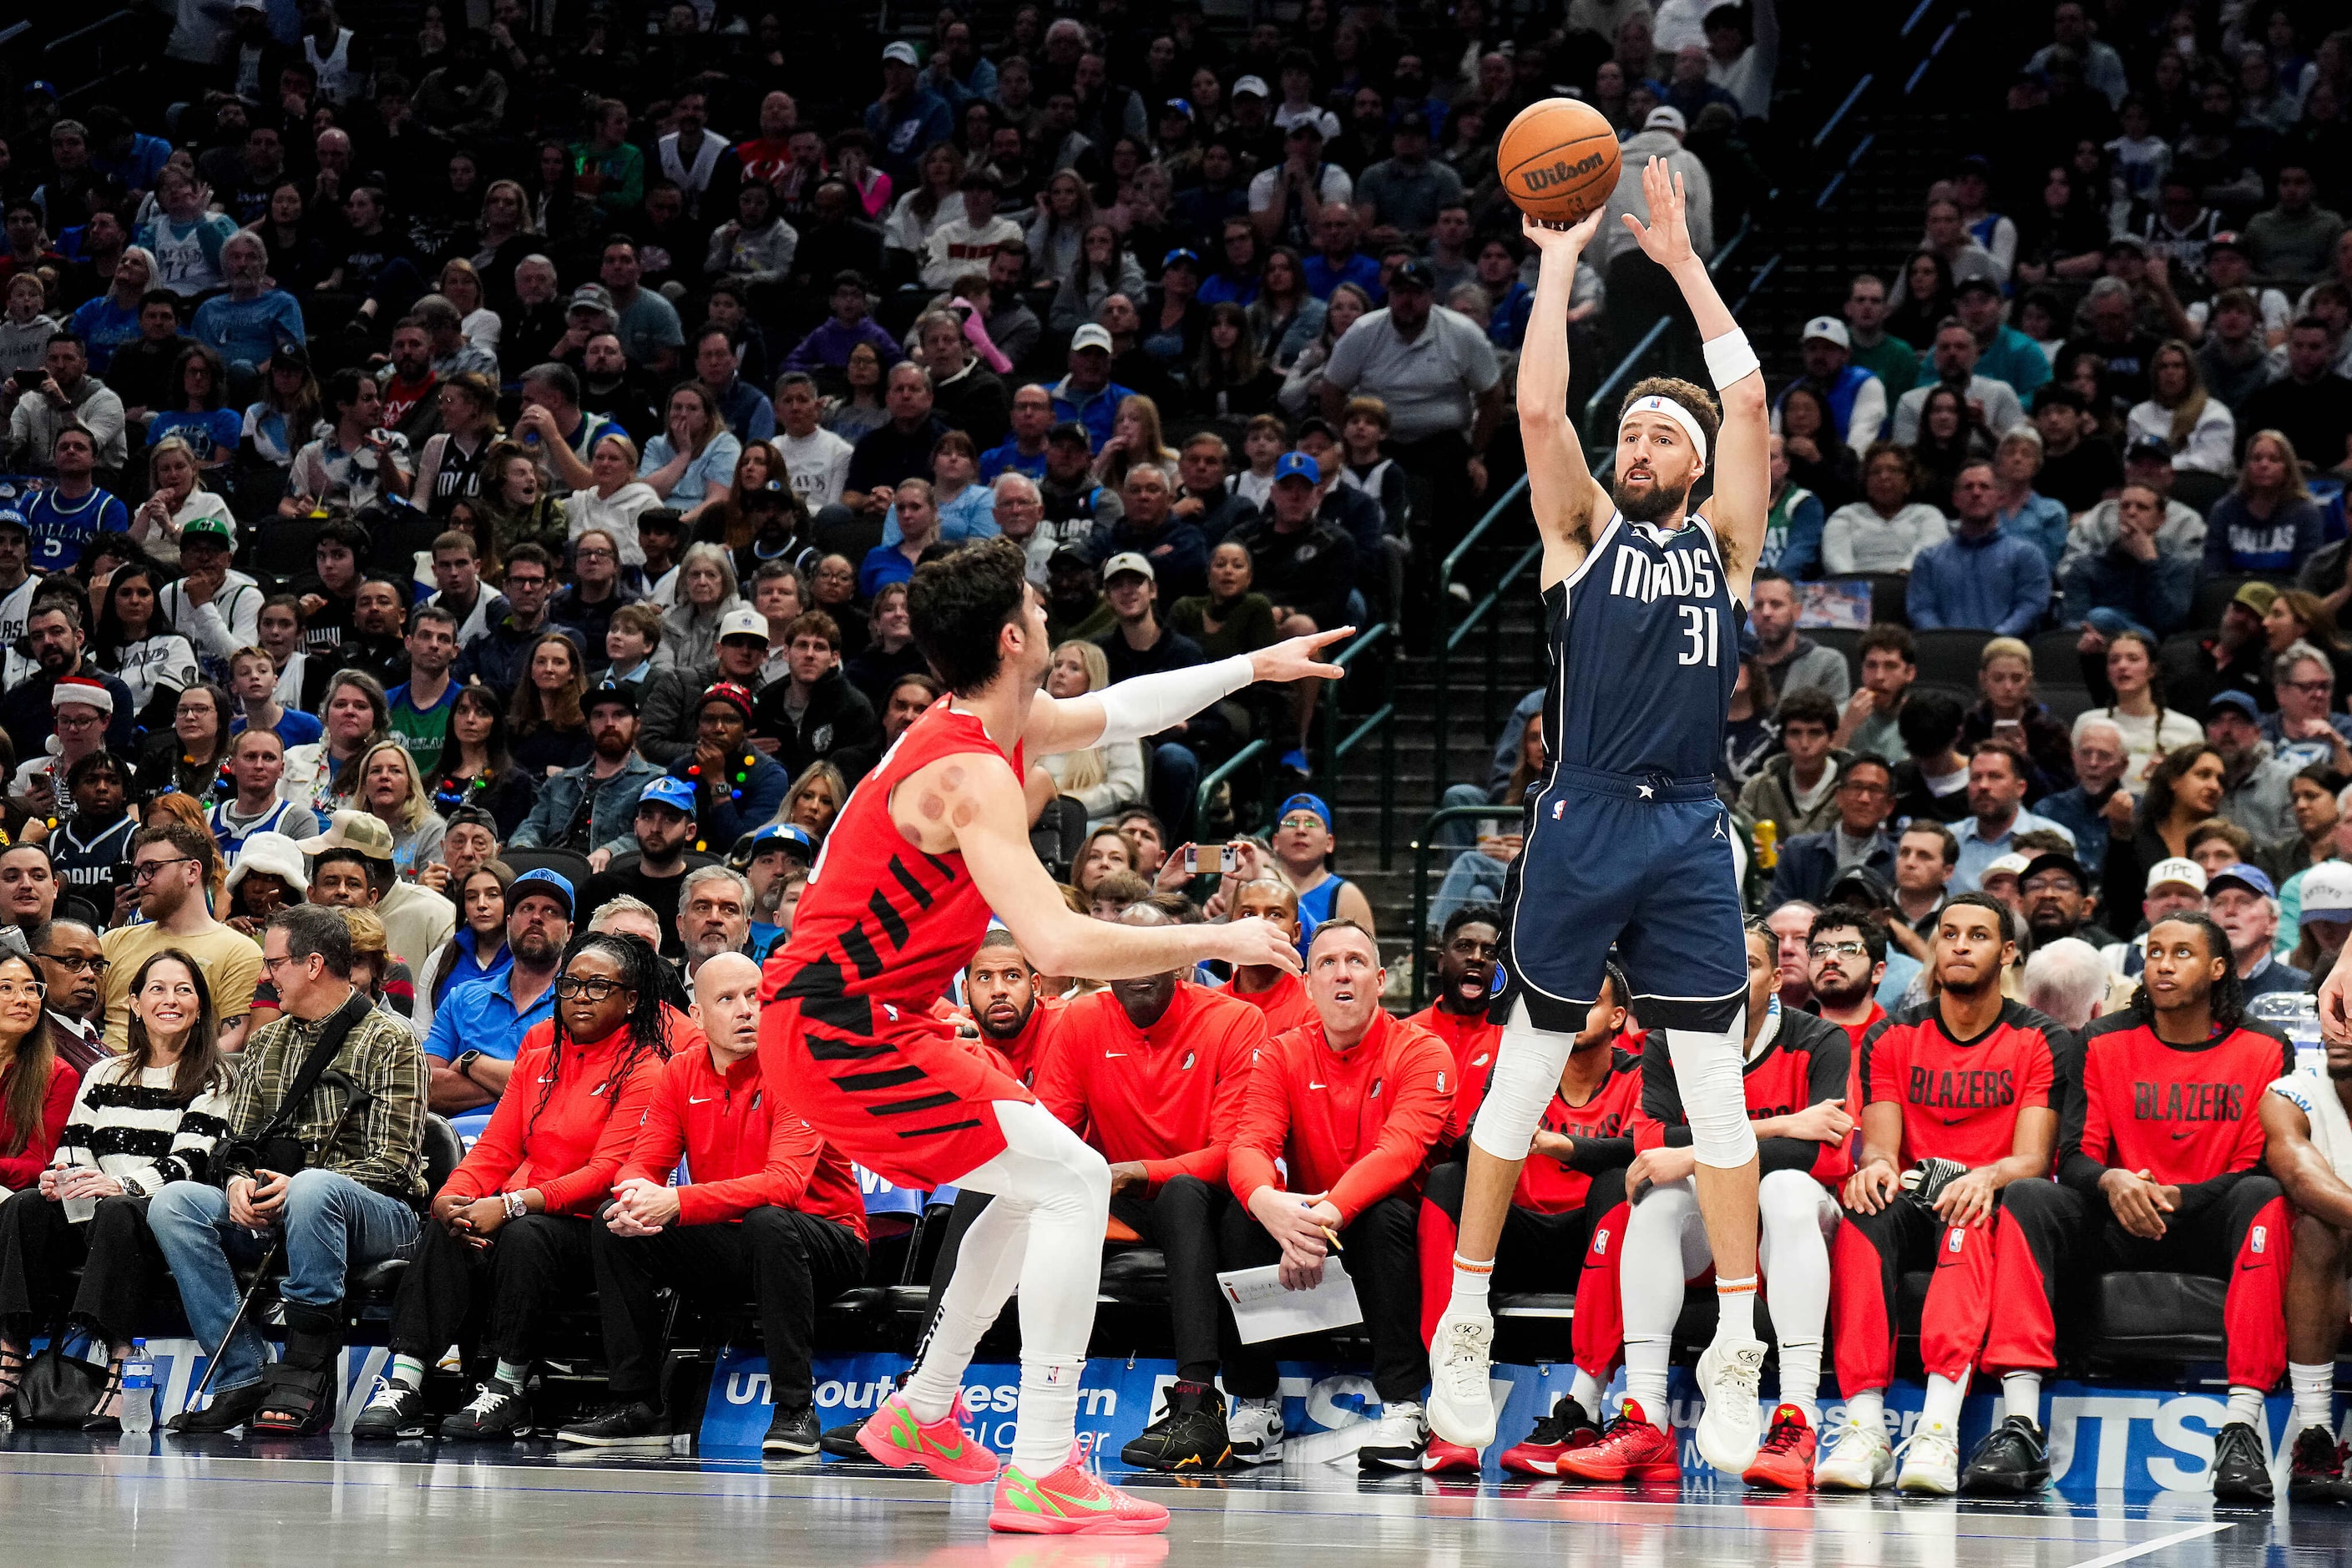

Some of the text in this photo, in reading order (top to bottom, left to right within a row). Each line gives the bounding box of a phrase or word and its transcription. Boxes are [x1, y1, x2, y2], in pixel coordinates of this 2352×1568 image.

[1522, 152, 1604, 191] Wilson
[43, 538, 62, 558] 5
[1678, 604, 1718, 667] 31
[2162, 863, 2192, 878] TPC
[1909, 1066, 2015, 1109] BLAZERS
[2134, 1082, 2244, 1122] BLAZERS
